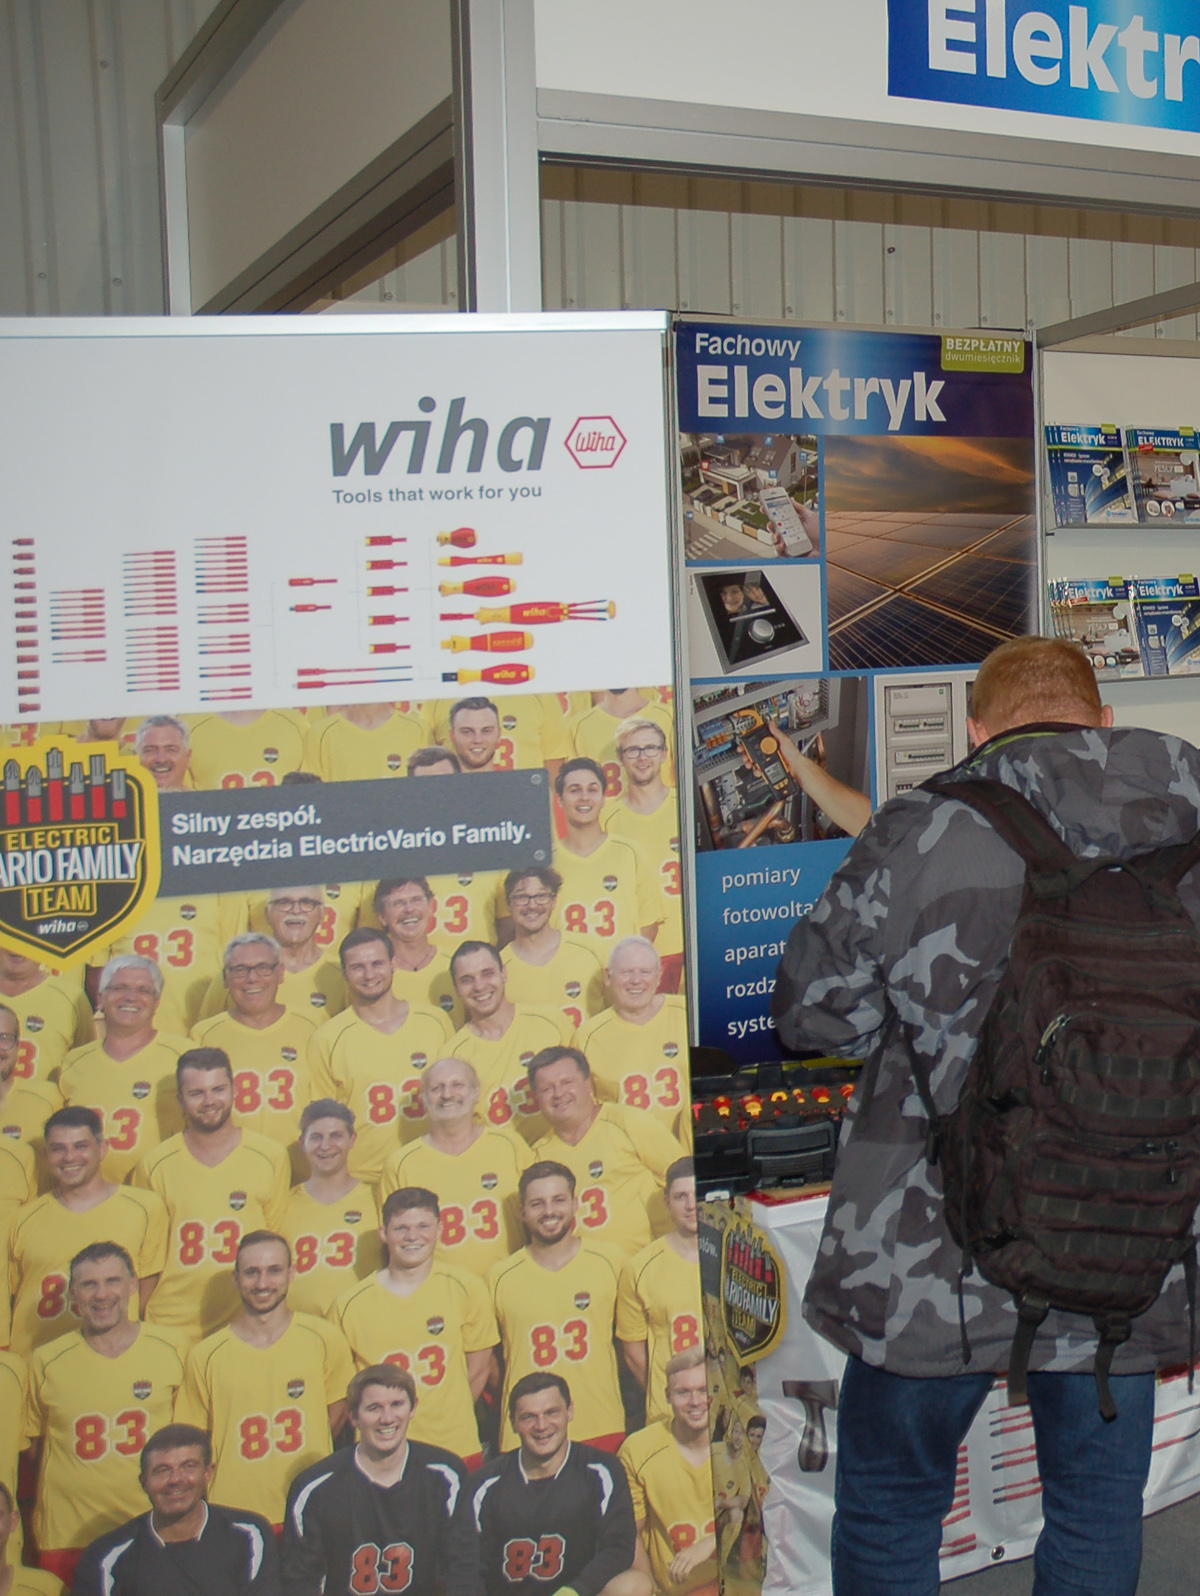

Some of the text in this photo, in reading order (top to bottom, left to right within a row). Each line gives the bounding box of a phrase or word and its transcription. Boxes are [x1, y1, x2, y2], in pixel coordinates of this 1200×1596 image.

[695, 333, 801, 361] Fachowy
[945, 351, 1021, 364] dwumiesięcznik
[946, 338, 1021, 353] BEZPŁATNY
[696, 364, 947, 431] Elektryk
[330, 396, 551, 477] wiha
[1061, 432, 1106, 446] Elektryk
[1138, 436, 1184, 447] ELEKTRYK
[332, 484, 542, 504] Tools that work for you
[1068, 587, 1114, 599] Elektryk
[1139, 585, 1184, 597] Elektryk
[522, 608, 546, 617] wiha
[493, 670, 516, 679] wiha
[6, 825, 111, 850] ELECTRIC
[171, 805, 322, 836] Silny zespół.
[58, 842, 141, 881] FAMILY
[172, 820, 532, 867] Narzędzia ElectricVario Family.
[722, 866, 801, 893] pomiary
[27, 885, 91, 914] TEAM
[565, 900, 615, 937] 83
[723, 897, 818, 926] fotowolta
[38, 920, 76, 935] wiha
[134, 928, 193, 968] 83
[234, 1069, 295, 1114] 83
[368, 1078, 424, 1124] 83
[488, 1077, 540, 1125] 83
[623, 1067, 680, 1110] 83
[94, 1108, 141, 1151] 3
[440, 1200, 499, 1246] 83
[179, 1220, 240, 1266] 83
[295, 1232, 355, 1273] 83
[37, 1274, 82, 1319] 8
[531, 1319, 588, 1367] 83
[75, 1410, 148, 1460] 83
[240, 1408, 304, 1460] 83
[351, 1542, 414, 1595] 83
[504, 1533, 565, 1583] 83
